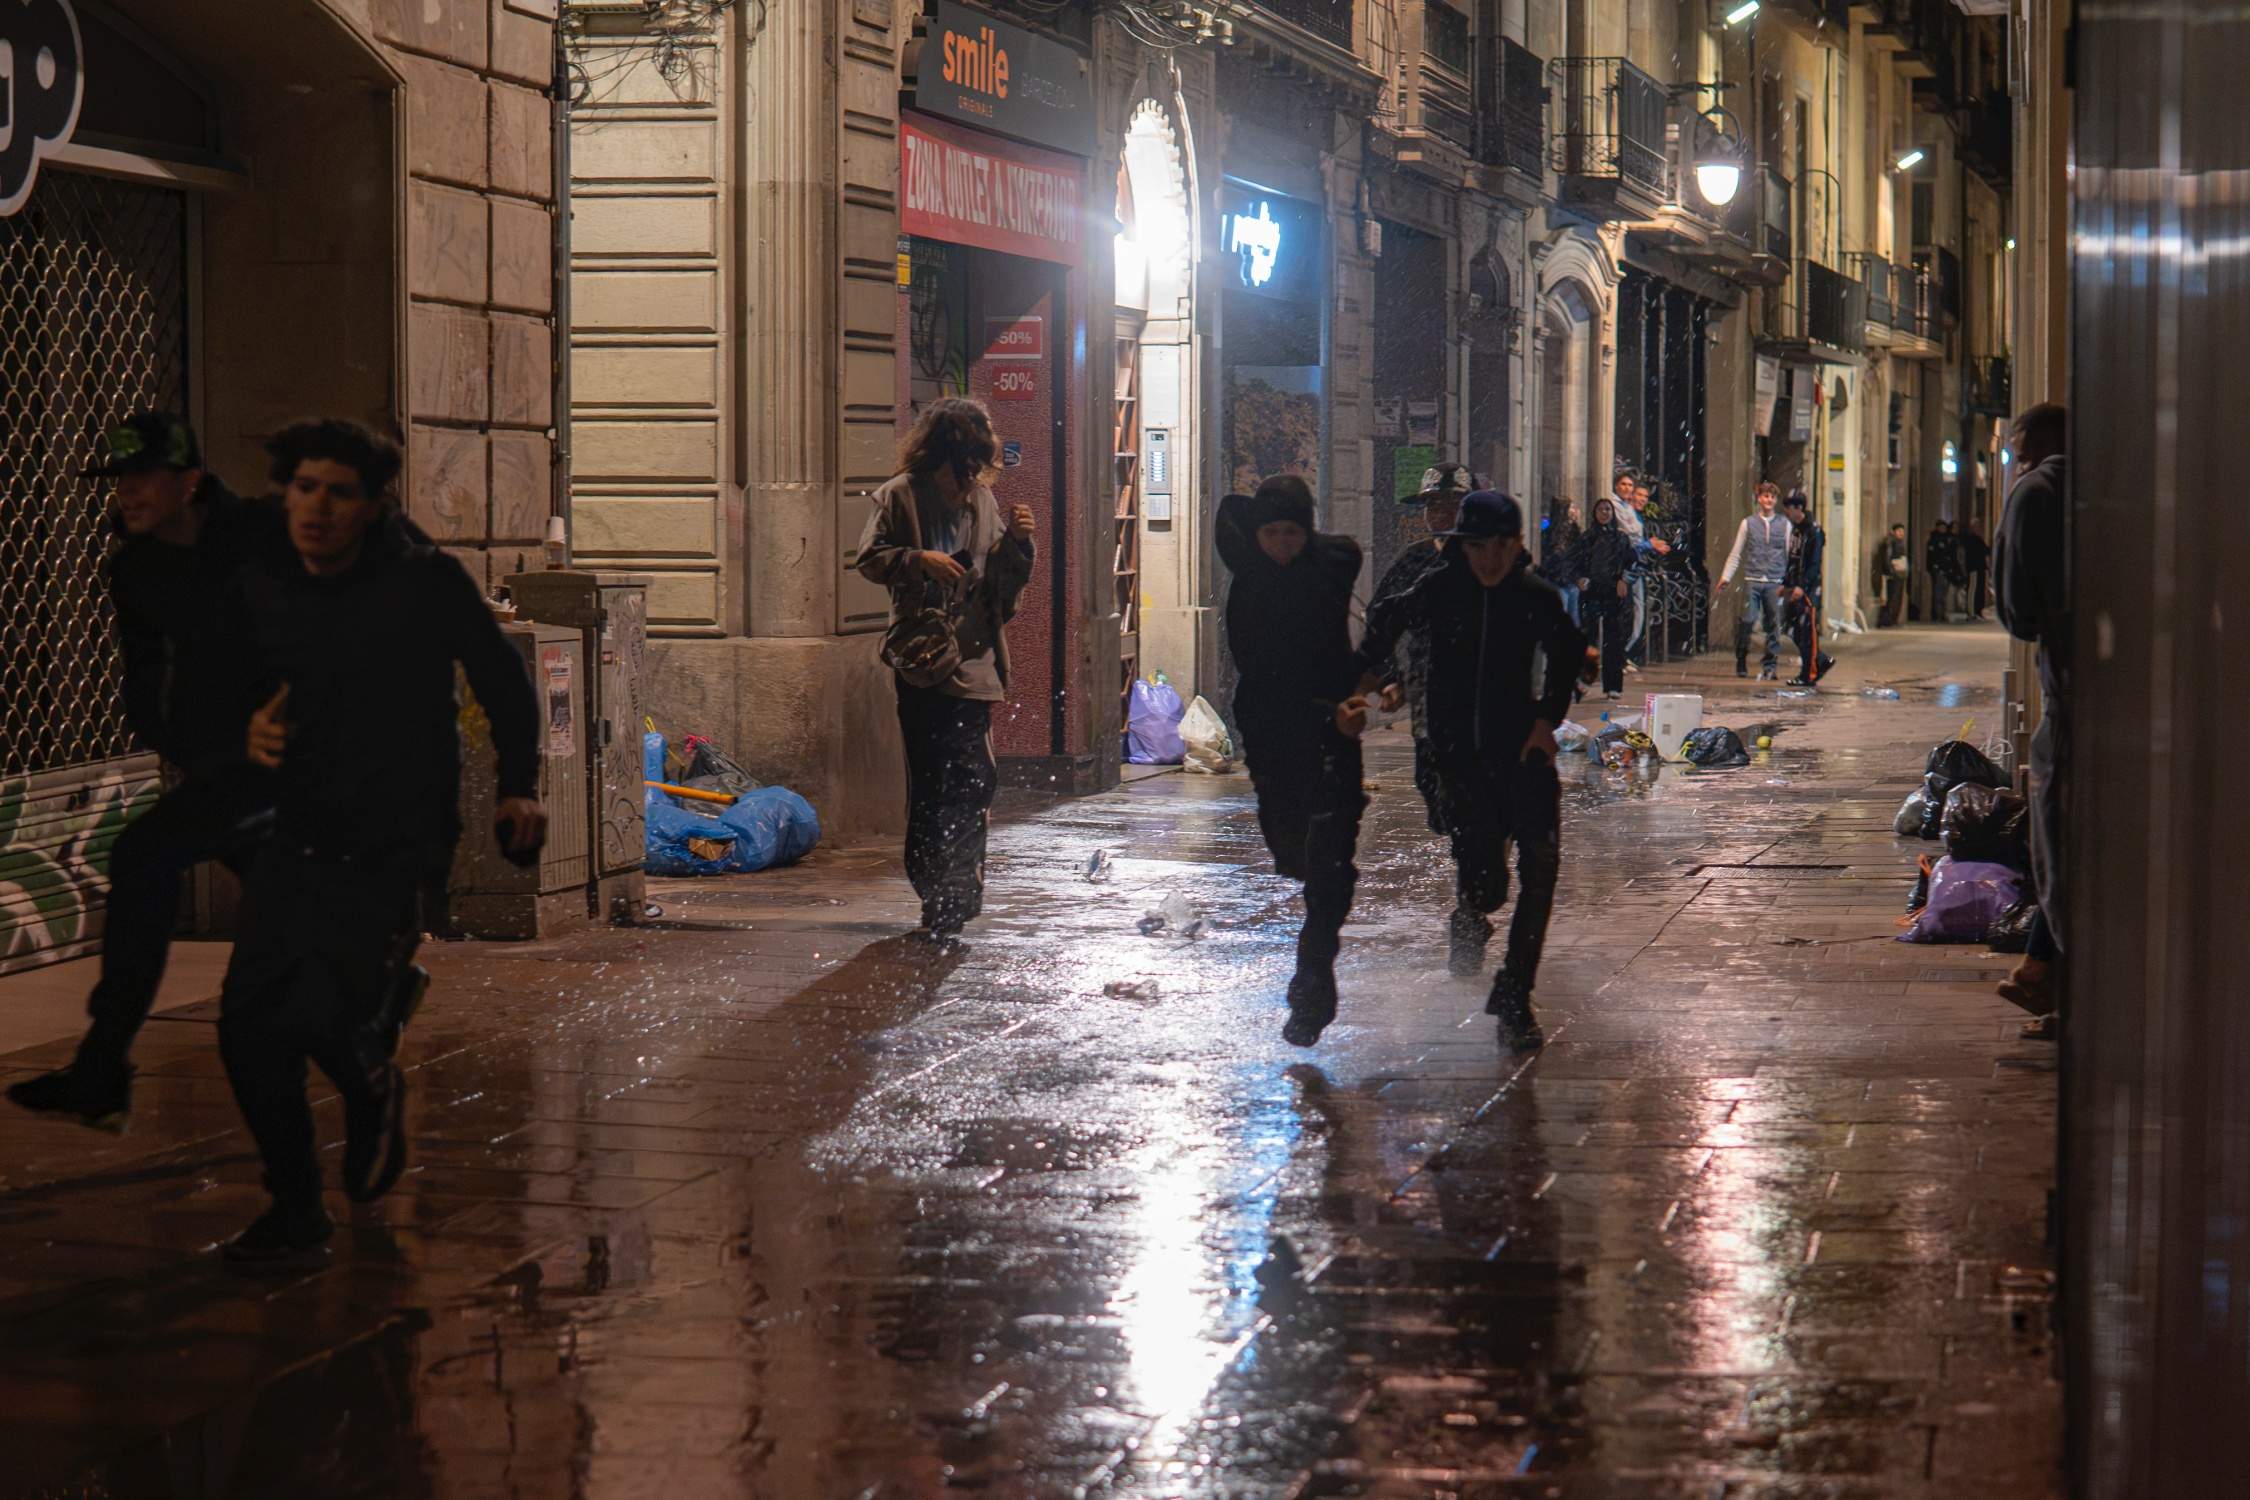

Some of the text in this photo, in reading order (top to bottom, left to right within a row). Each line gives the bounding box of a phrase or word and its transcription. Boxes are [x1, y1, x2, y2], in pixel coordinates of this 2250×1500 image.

[943, 26, 1009, 99] smile
[906, 135, 945, 215] ZONA
[945, 146, 992, 226] OUTLET
[993, 372, 1034, 392] -50%
